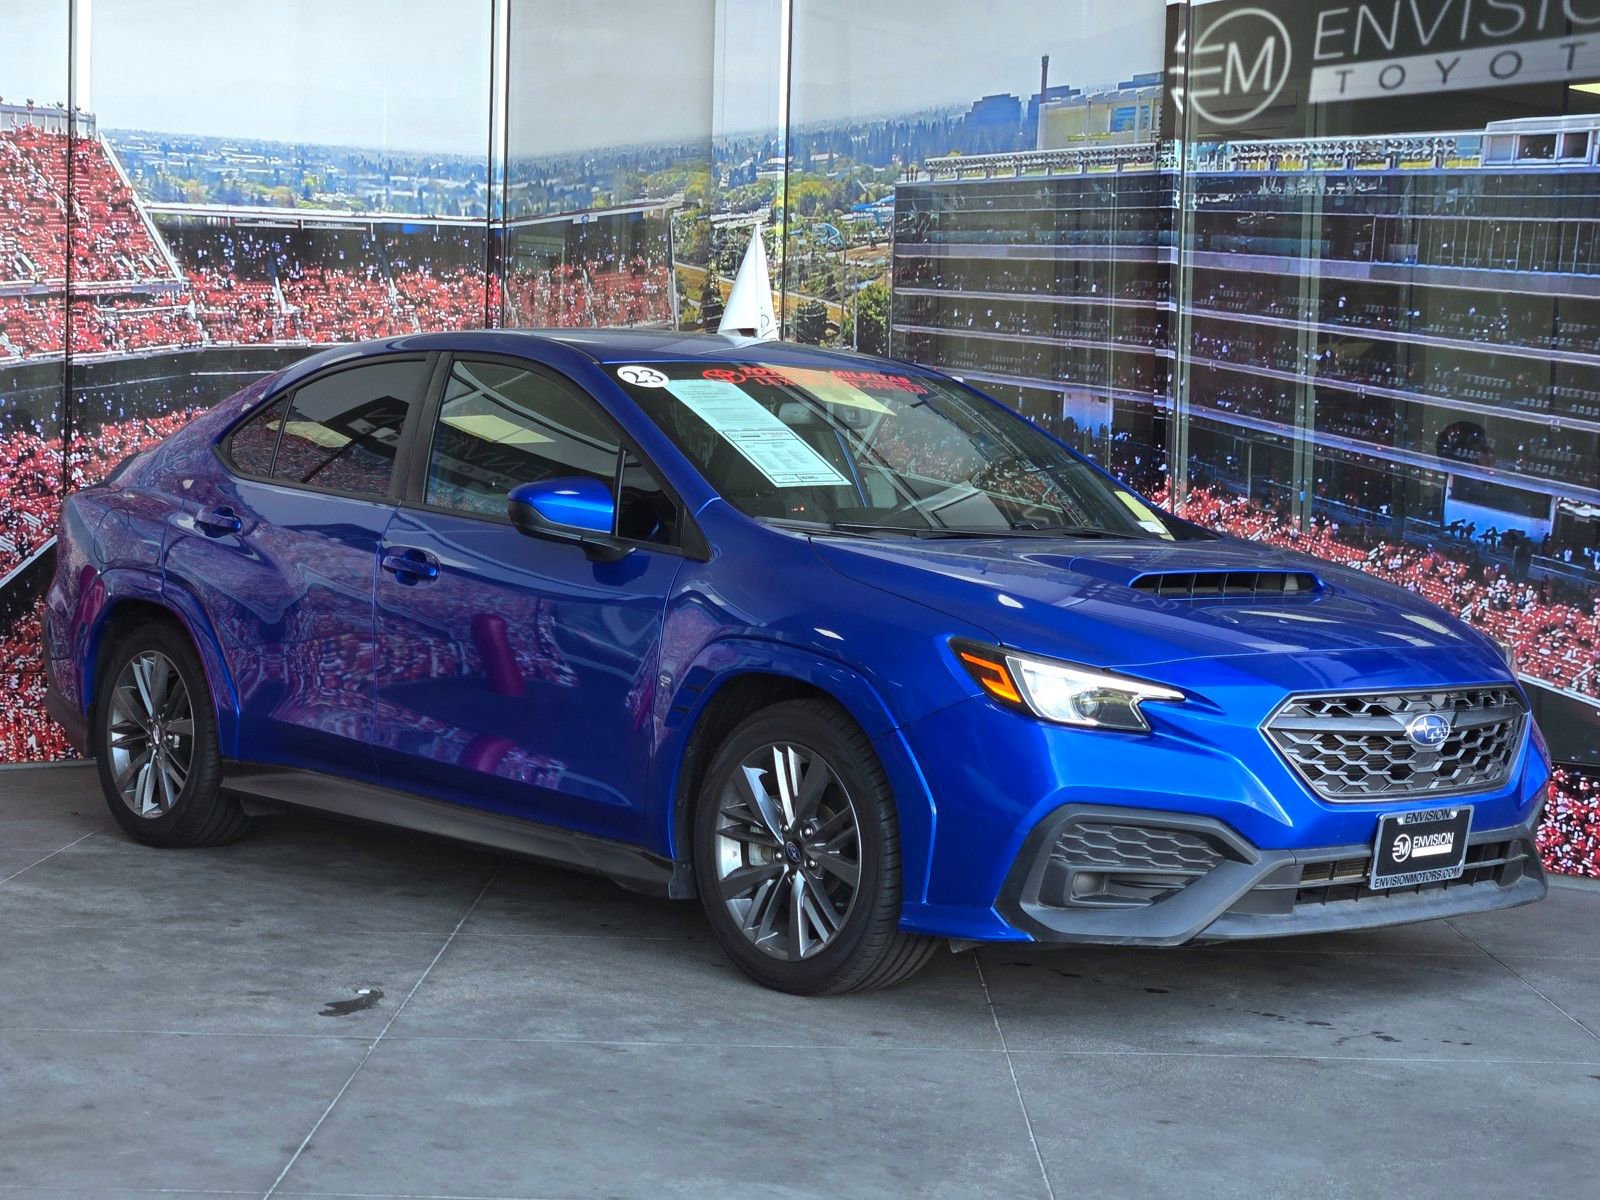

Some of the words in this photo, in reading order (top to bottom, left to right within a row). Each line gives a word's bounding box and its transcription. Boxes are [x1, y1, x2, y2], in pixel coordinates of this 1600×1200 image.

[622, 369, 664, 384] 23
[1404, 808, 1451, 824] ENVISION
[1412, 832, 1454, 848] ENVISION
[1374, 867, 1460, 888] ENVISIONMOTORS.COM
